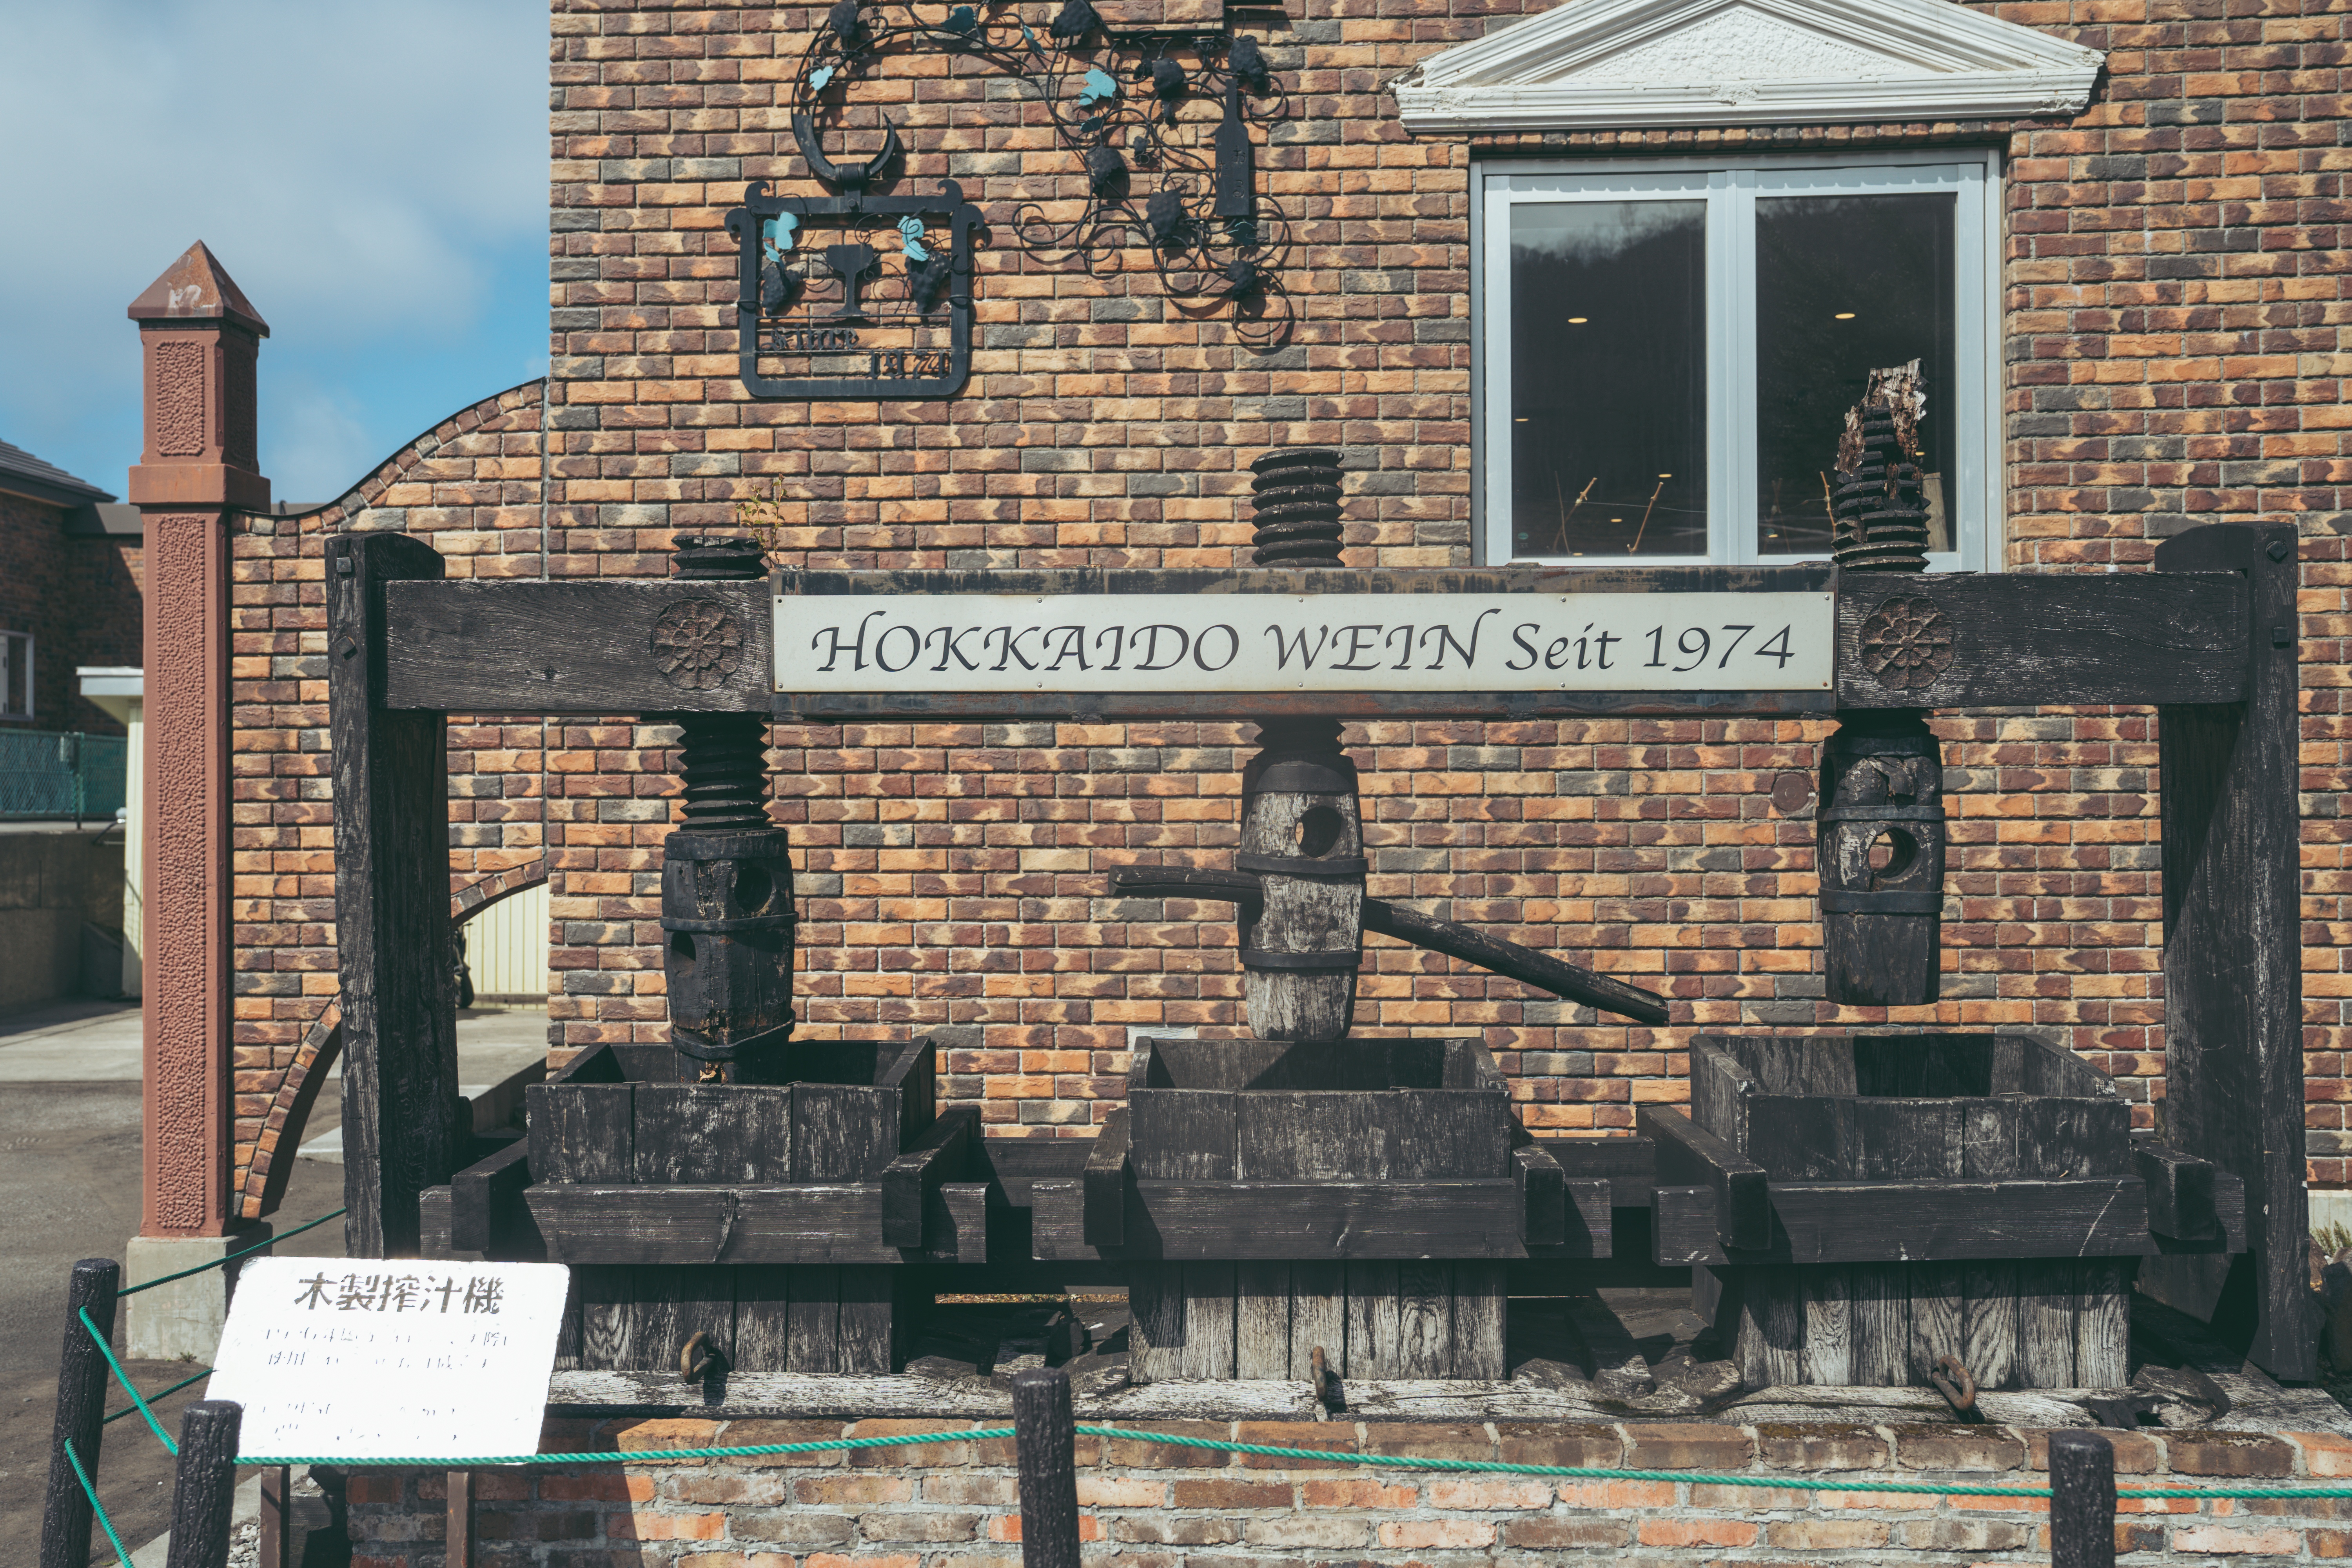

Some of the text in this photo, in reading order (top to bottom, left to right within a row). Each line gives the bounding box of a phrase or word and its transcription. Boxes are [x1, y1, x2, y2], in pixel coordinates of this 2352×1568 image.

[759, 323, 857, 351] Since
[866, 348, 947, 379] 1974
[812, 608, 1795, 672] HOKKAIDO WEIN Seit 1974
[294, 1272, 504, 1314] 木製搾汁機
